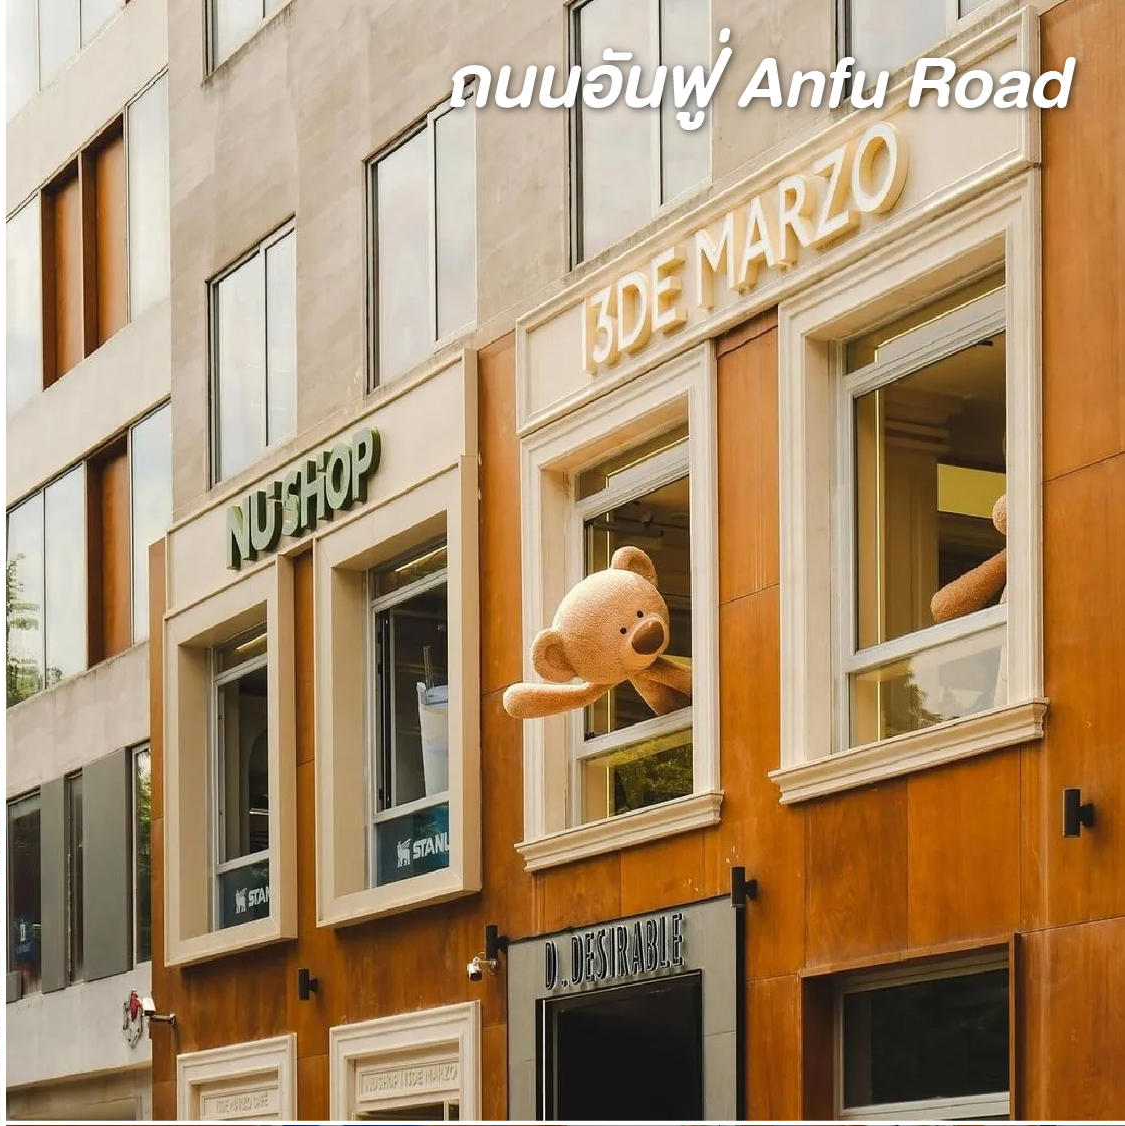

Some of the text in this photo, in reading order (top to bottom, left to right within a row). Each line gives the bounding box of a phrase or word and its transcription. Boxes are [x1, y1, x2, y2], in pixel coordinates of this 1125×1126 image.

[695, 121, 909, 310] MARZO
[226, 425, 381, 571] NUSHOP
[572, 913, 685, 986] DESIRABLE
